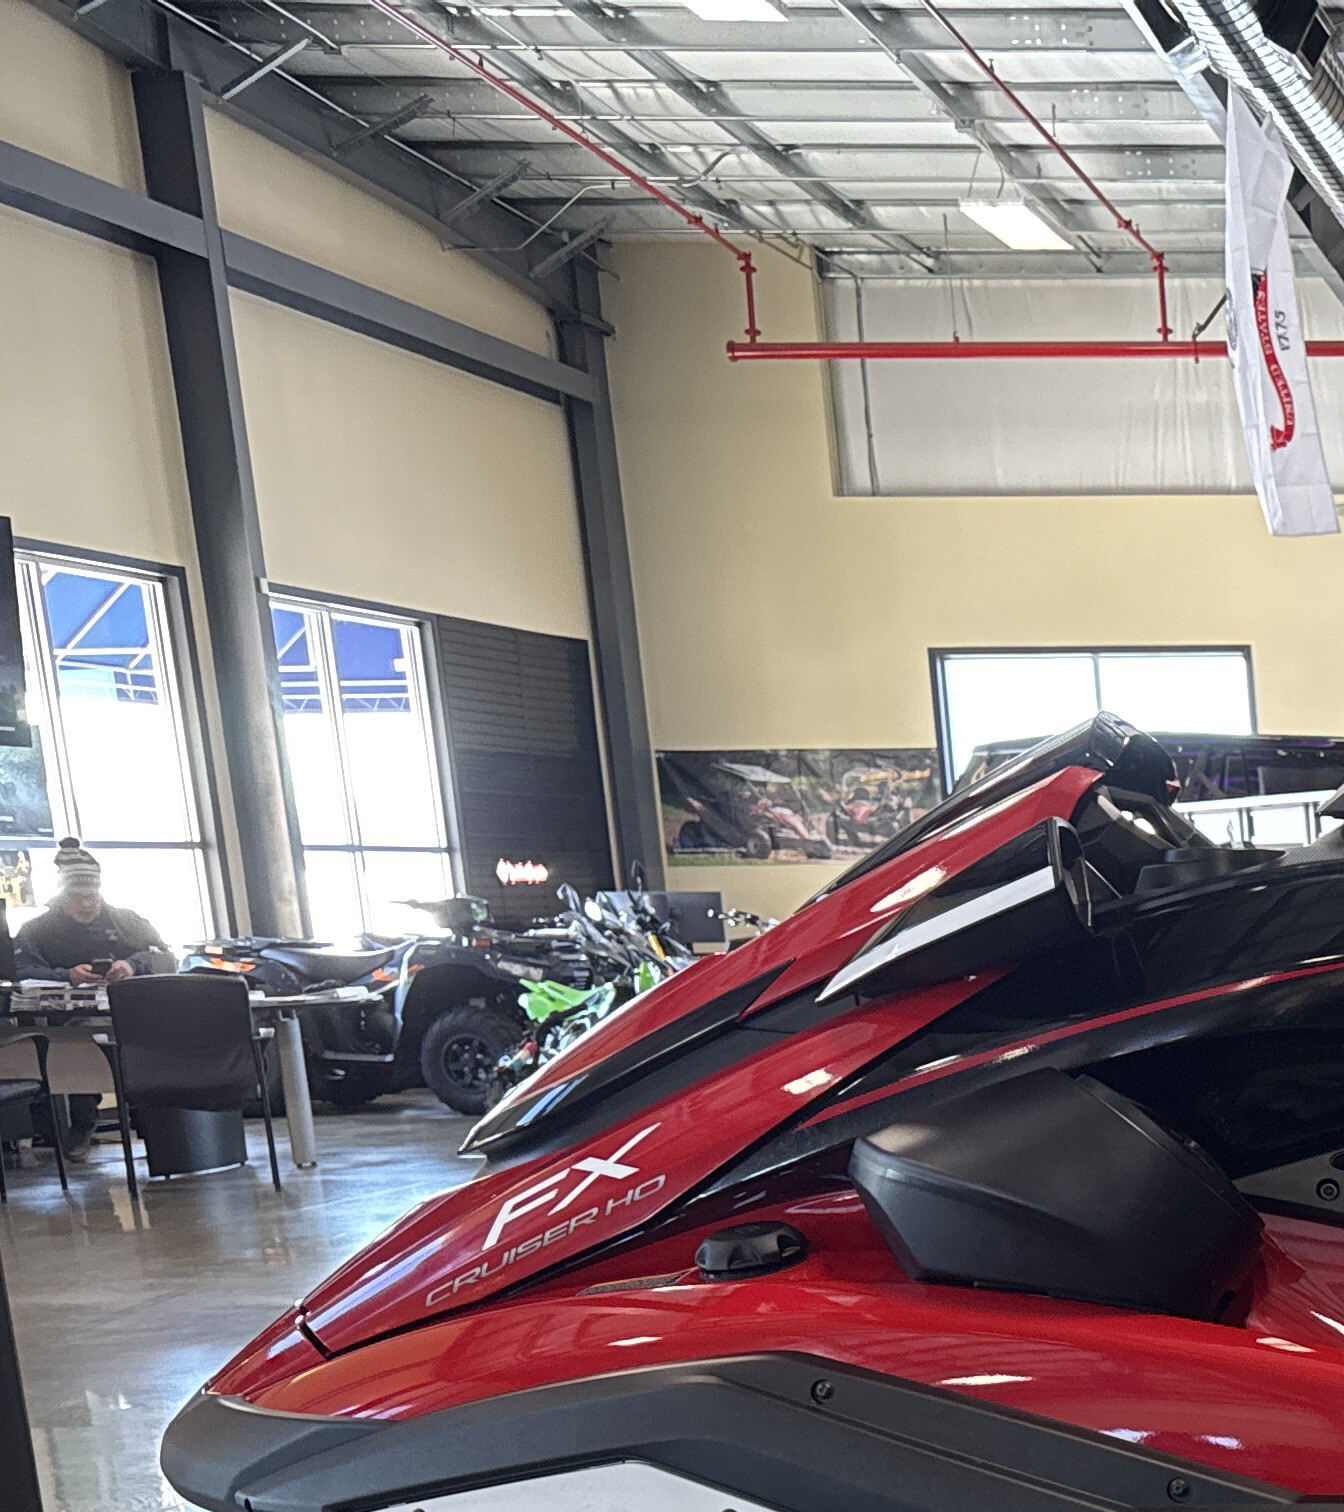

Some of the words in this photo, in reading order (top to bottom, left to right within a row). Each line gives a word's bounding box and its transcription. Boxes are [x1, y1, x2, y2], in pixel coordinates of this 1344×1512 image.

[425, 1206, 600, 1307] CRUISER
[604, 1174, 667, 1216] HO
[482, 1122, 662, 1251] FX
